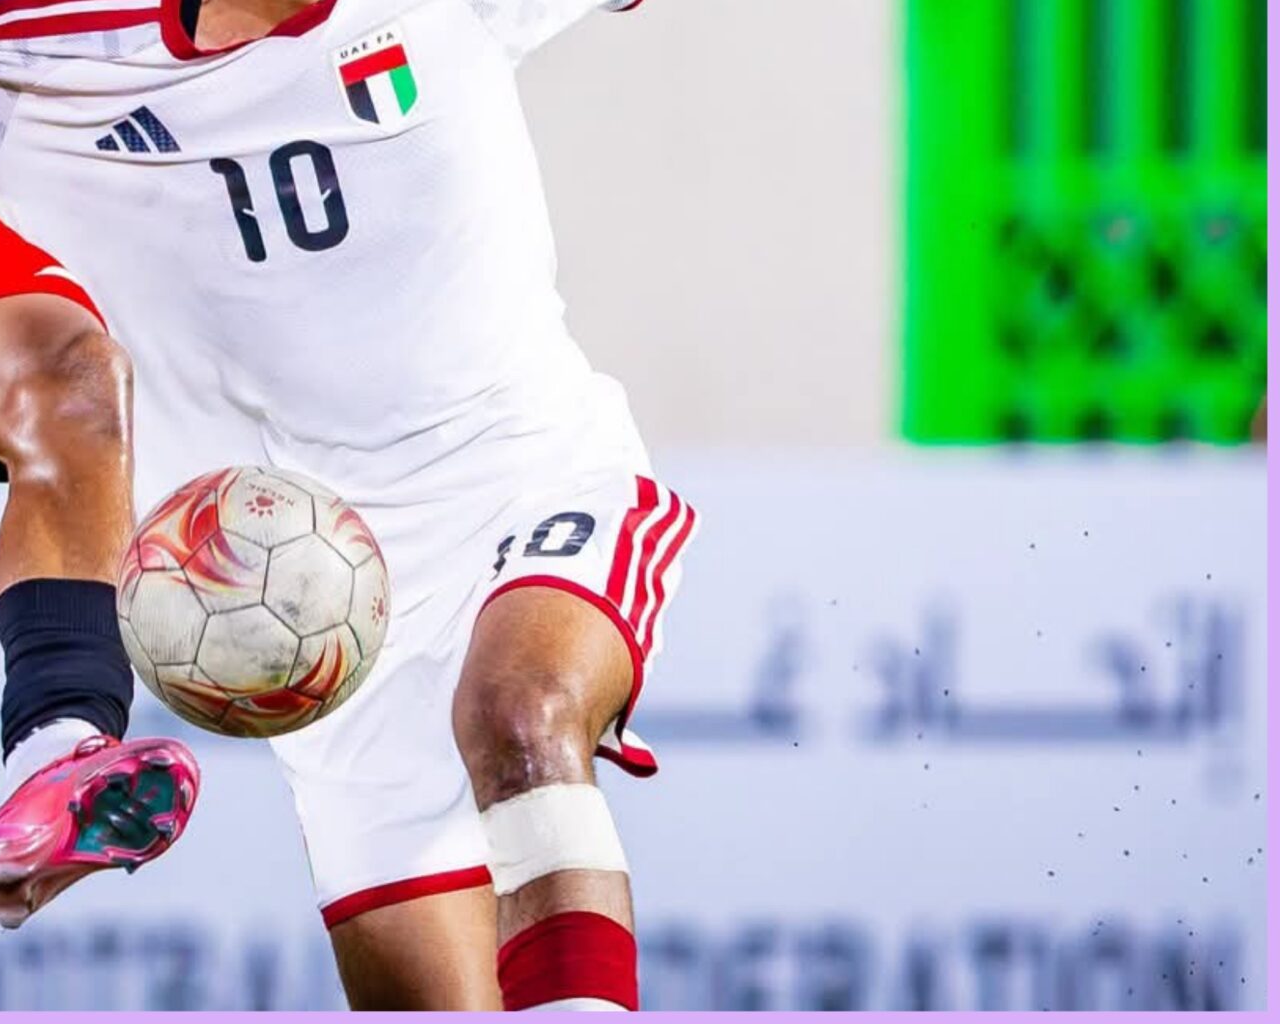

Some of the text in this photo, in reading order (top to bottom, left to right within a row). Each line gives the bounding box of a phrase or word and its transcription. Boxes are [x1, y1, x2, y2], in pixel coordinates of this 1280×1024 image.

[340, 31, 395, 59] UAE FA
[209, 139, 350, 263] 10
